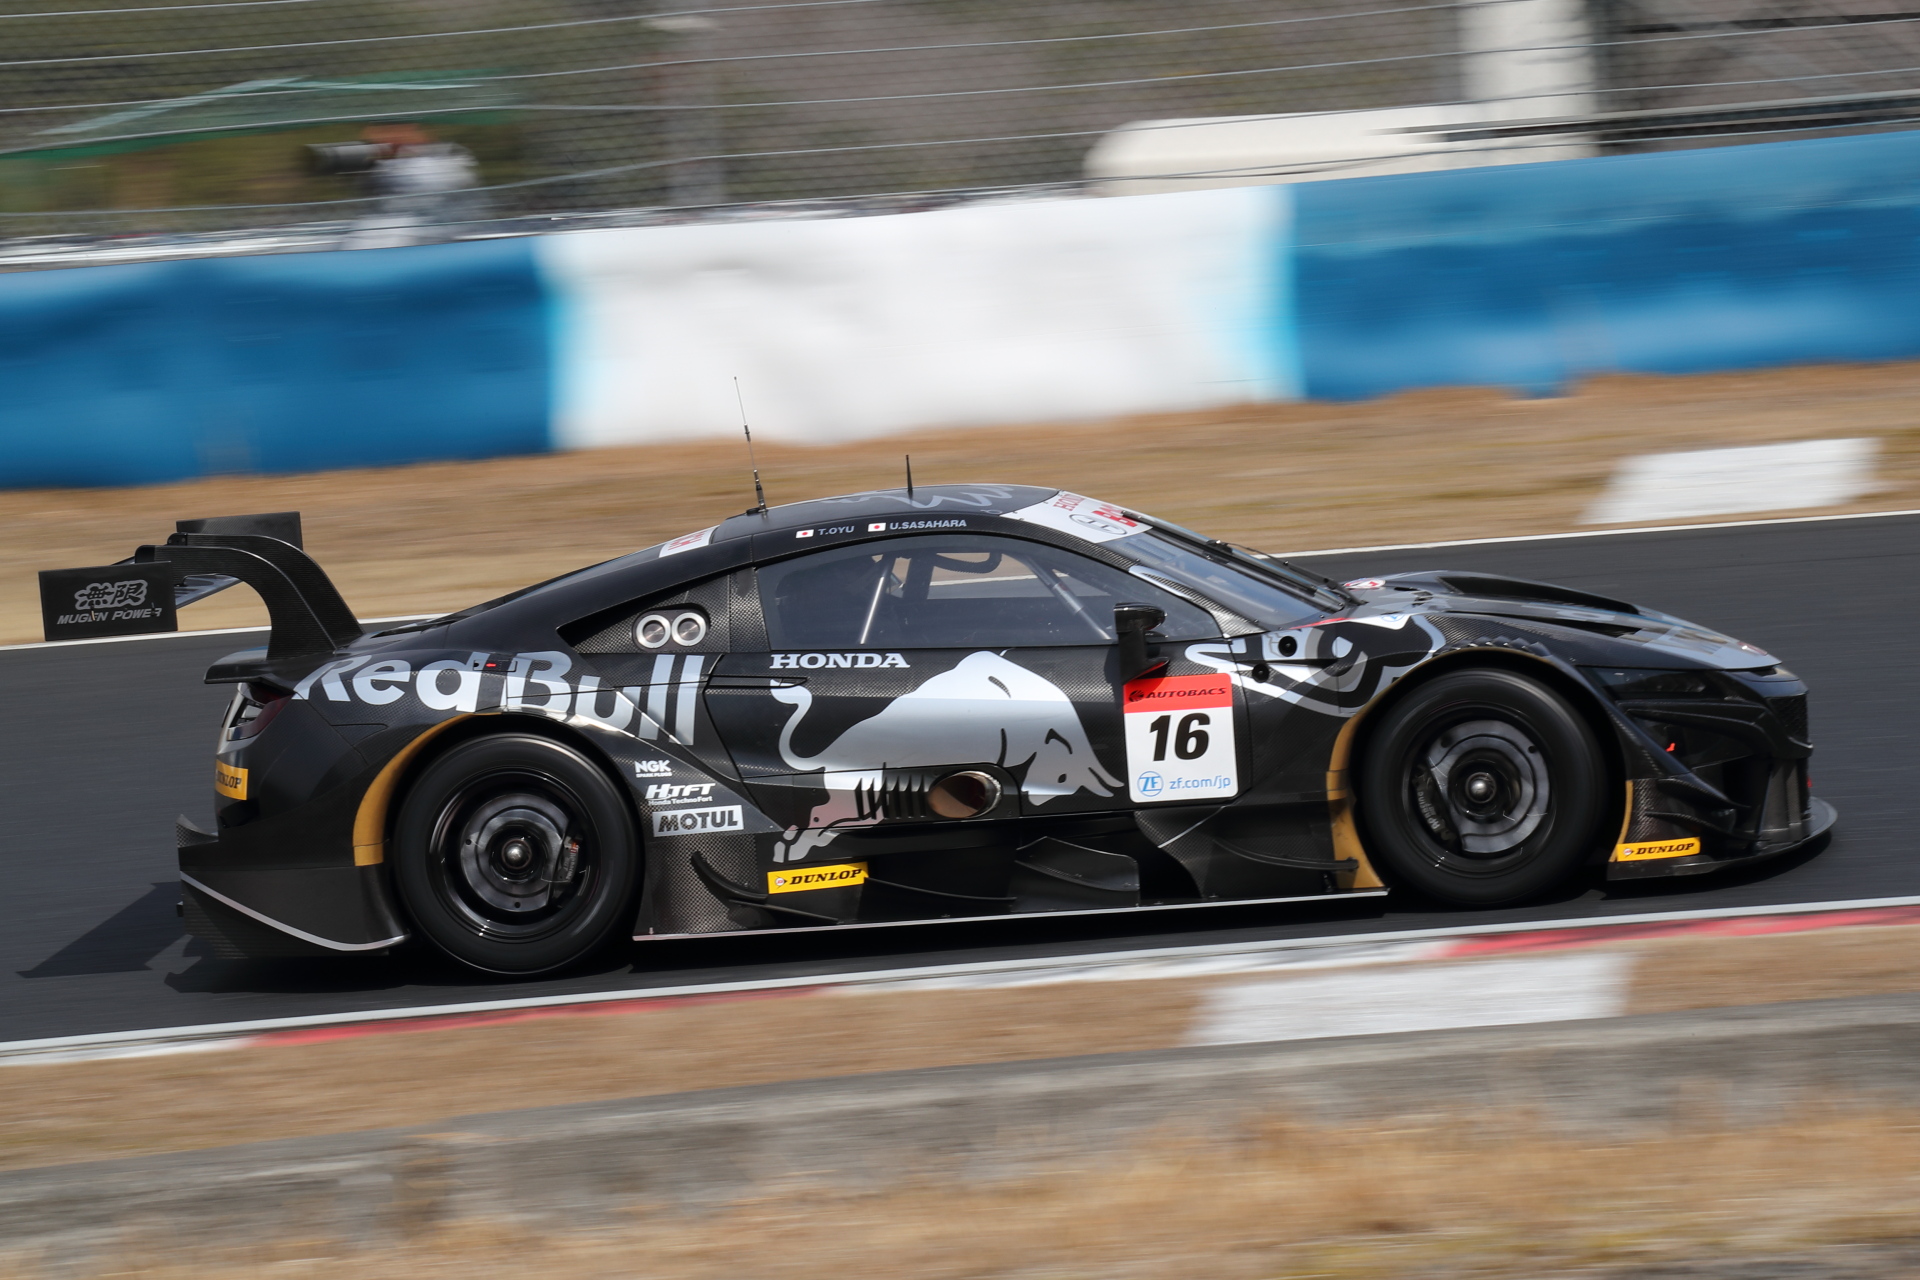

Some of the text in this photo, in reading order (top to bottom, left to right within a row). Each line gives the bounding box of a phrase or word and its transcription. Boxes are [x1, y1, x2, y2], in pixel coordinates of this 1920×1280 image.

[817, 525, 855, 536] T.OYU
[889, 519, 967, 530] U.SASAHARA
[75, 580, 148, 610] 無限
[57, 611, 109, 625] MUGEN
[769, 653, 911, 669] HONDA
[291, 650, 705, 746] Red Bull
[1146, 687, 1227, 699] AUTOBACS
[1149, 712, 1211, 762] 16
[634, 760, 672, 773] NGK
[1139, 775, 1231, 792] ZF zf.com/jp
[658, 810, 738, 832] MOTUL
[1636, 843, 1694, 855] DUNLOP
[790, 869, 862, 885] DUNLOP
